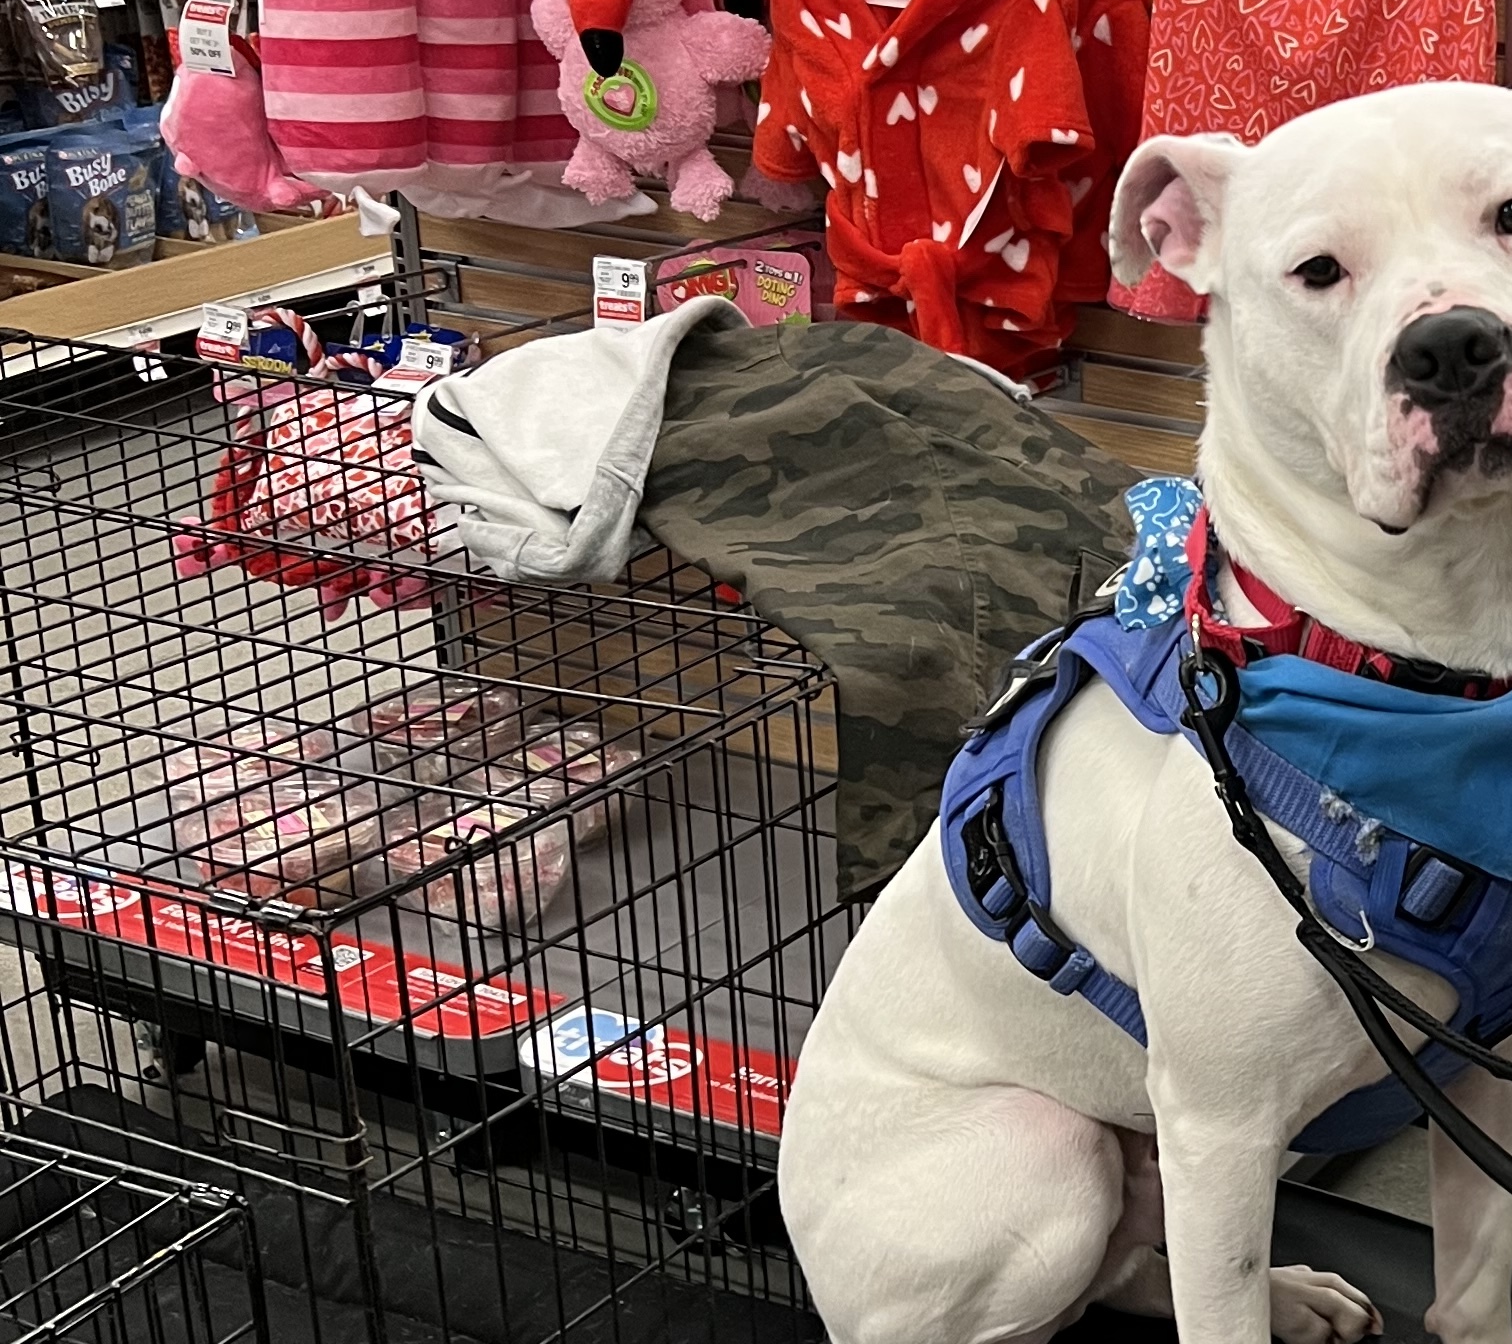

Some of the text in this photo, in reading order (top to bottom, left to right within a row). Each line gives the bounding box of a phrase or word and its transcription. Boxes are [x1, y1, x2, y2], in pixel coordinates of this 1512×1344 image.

[56, 72, 114, 114] Busy
[65, 152, 112, 188] Busy
[88, 168, 127, 197] Bone
[755, 261, 764, 273] 2
[756, 275, 796, 297] DOTING
[761, 290, 786, 307] DINO
